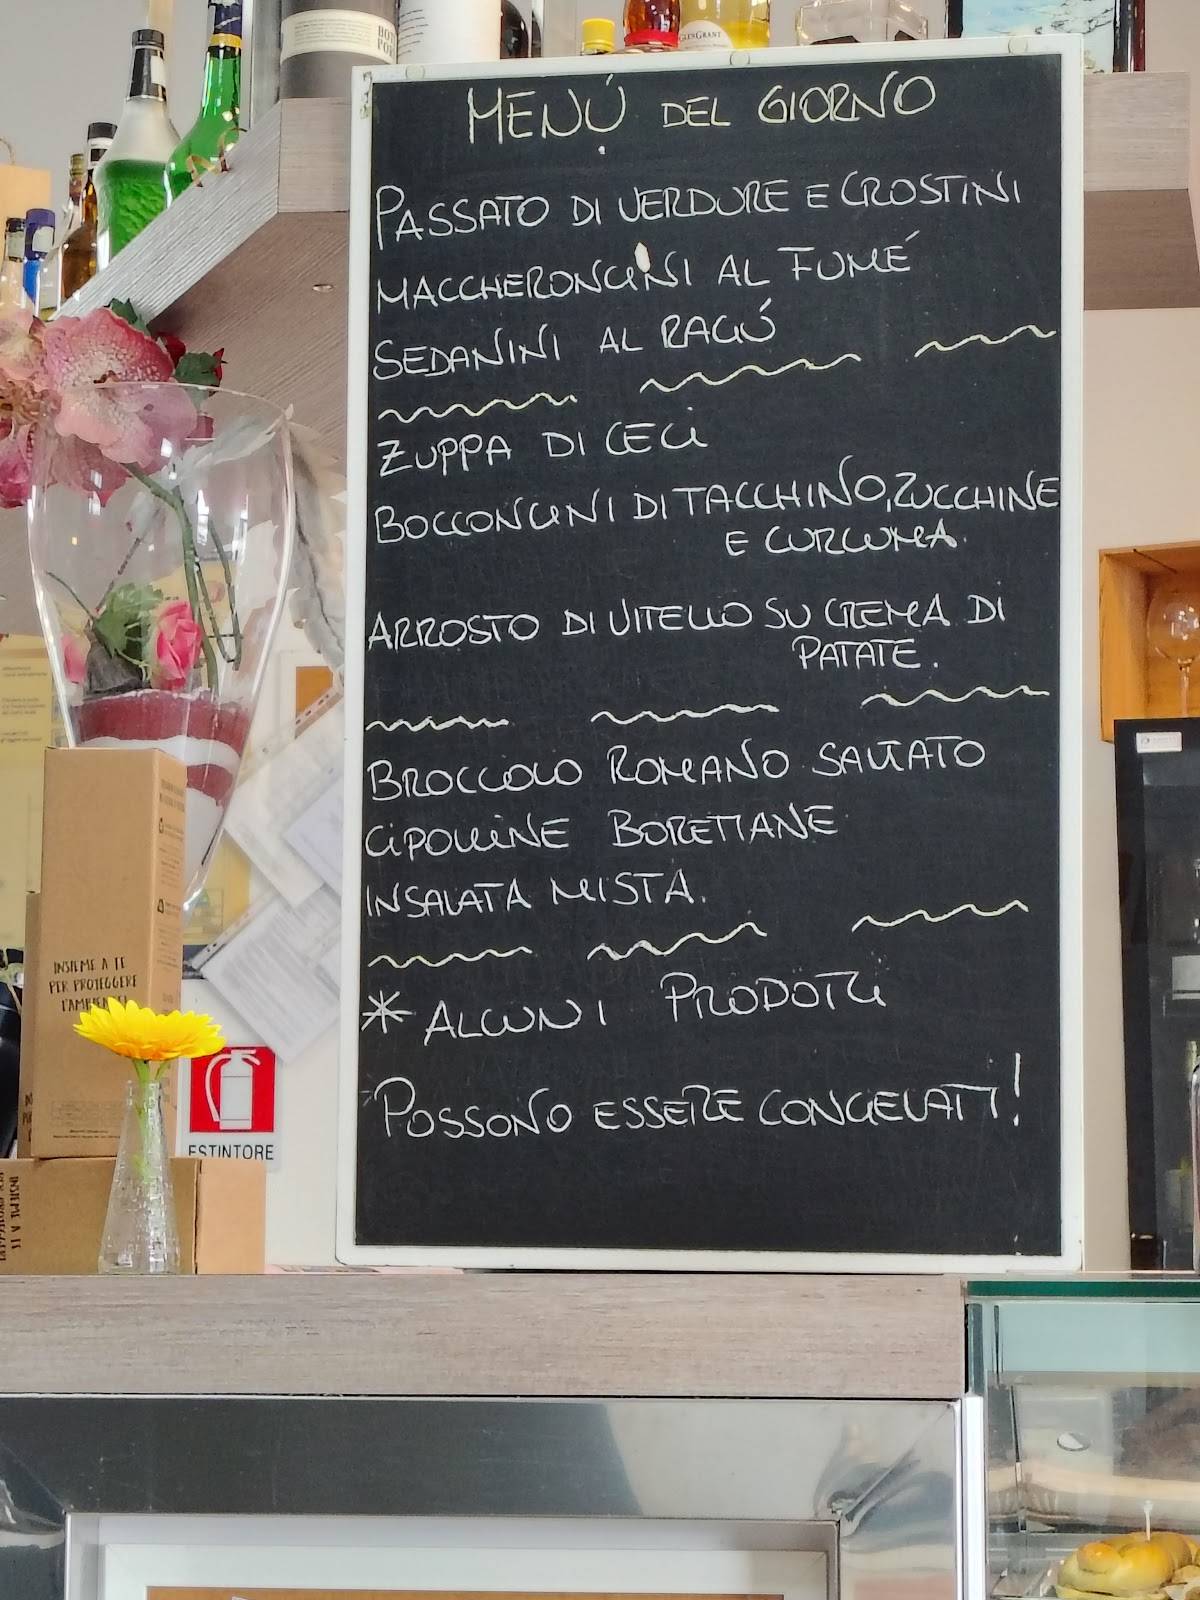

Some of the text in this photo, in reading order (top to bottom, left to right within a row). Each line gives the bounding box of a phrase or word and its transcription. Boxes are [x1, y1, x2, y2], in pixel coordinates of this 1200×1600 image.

[661, 96, 731, 128] DEL
[757, 71, 936, 123] GIORNO
[376, 171, 1021, 250] PASSATO DI VERDURE E CROSTINI
[376, 251, 693, 315] MACCHERONCINI
[718, 257, 770, 287] AL
[373, 323, 561, 381] SEDANINI
[599, 326, 644, 354] AL
[378, 434, 512, 477] ZUPPA
[542, 431, 585, 458] DI
[375, 489, 615, 544] BOCCONCINI
[633, 493, 668, 520] DI
[726, 531, 748, 556] E
[368, 594, 1006, 651] ARROSTO DI VITELLO SU CREMA DI
[366, 736, 986, 801] BROCCOLO ROMANO SALTATO
[608, 803, 838, 849] BORETTANE
[366, 878, 532, 918] INSALATA
[49, 975, 136, 994] PER PROTEGGERE
[54, 957, 124, 974] INSIEME A TE
[424, 1000, 606, 1046] ALCUNI
[374, 1077, 573, 1138] POSSONO
[593, 1085, 744, 1129] ESSERE
[188, 1145, 274, 1160] ESTINTORE
